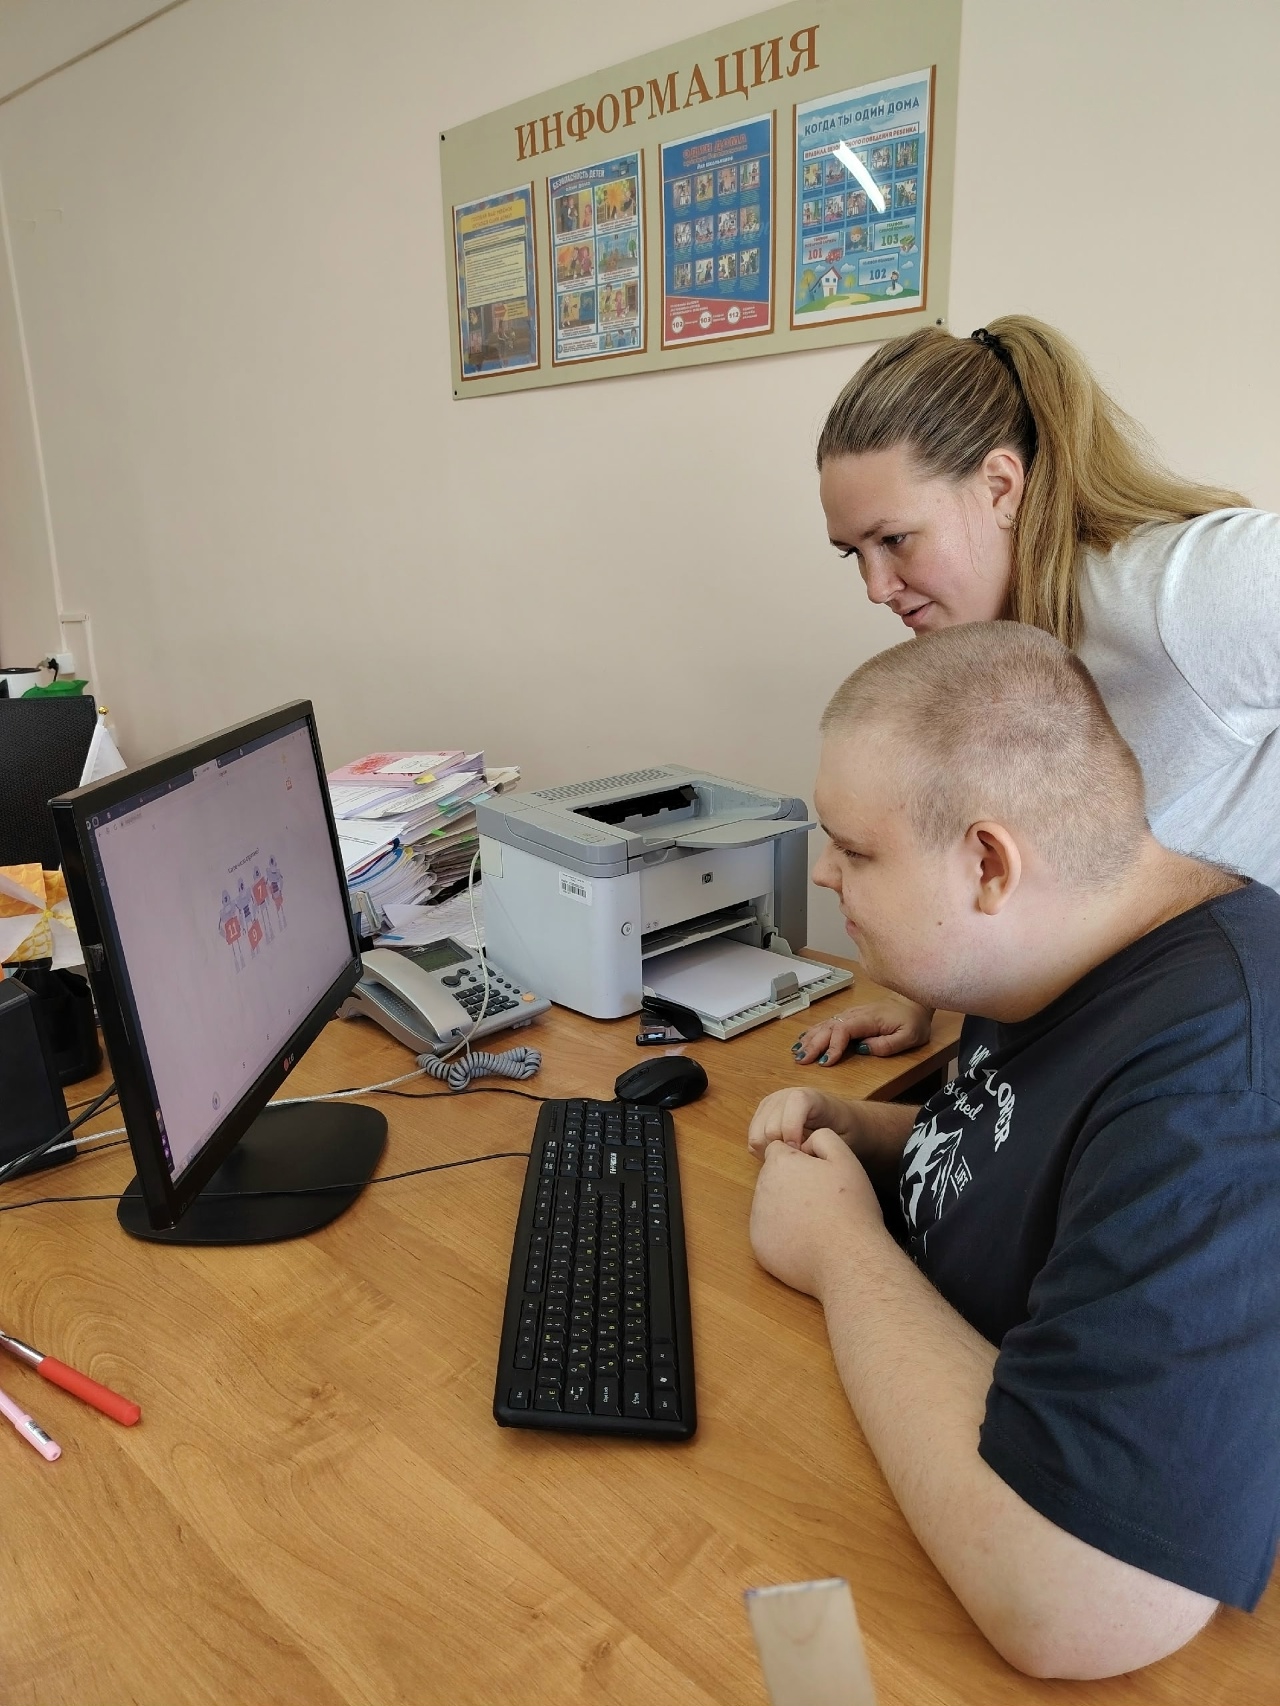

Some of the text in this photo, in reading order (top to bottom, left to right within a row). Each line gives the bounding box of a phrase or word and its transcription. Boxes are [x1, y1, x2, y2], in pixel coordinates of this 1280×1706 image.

[514, 24, 820, 161] ИНФОРМАЦИЯ
[804, 97, 920, 136] КОГДА ТЫ ОДИН ДОМА
[881, 233, 899, 247] 103
[807, 247, 823, 260] 101
[869, 268, 887, 281] 102
